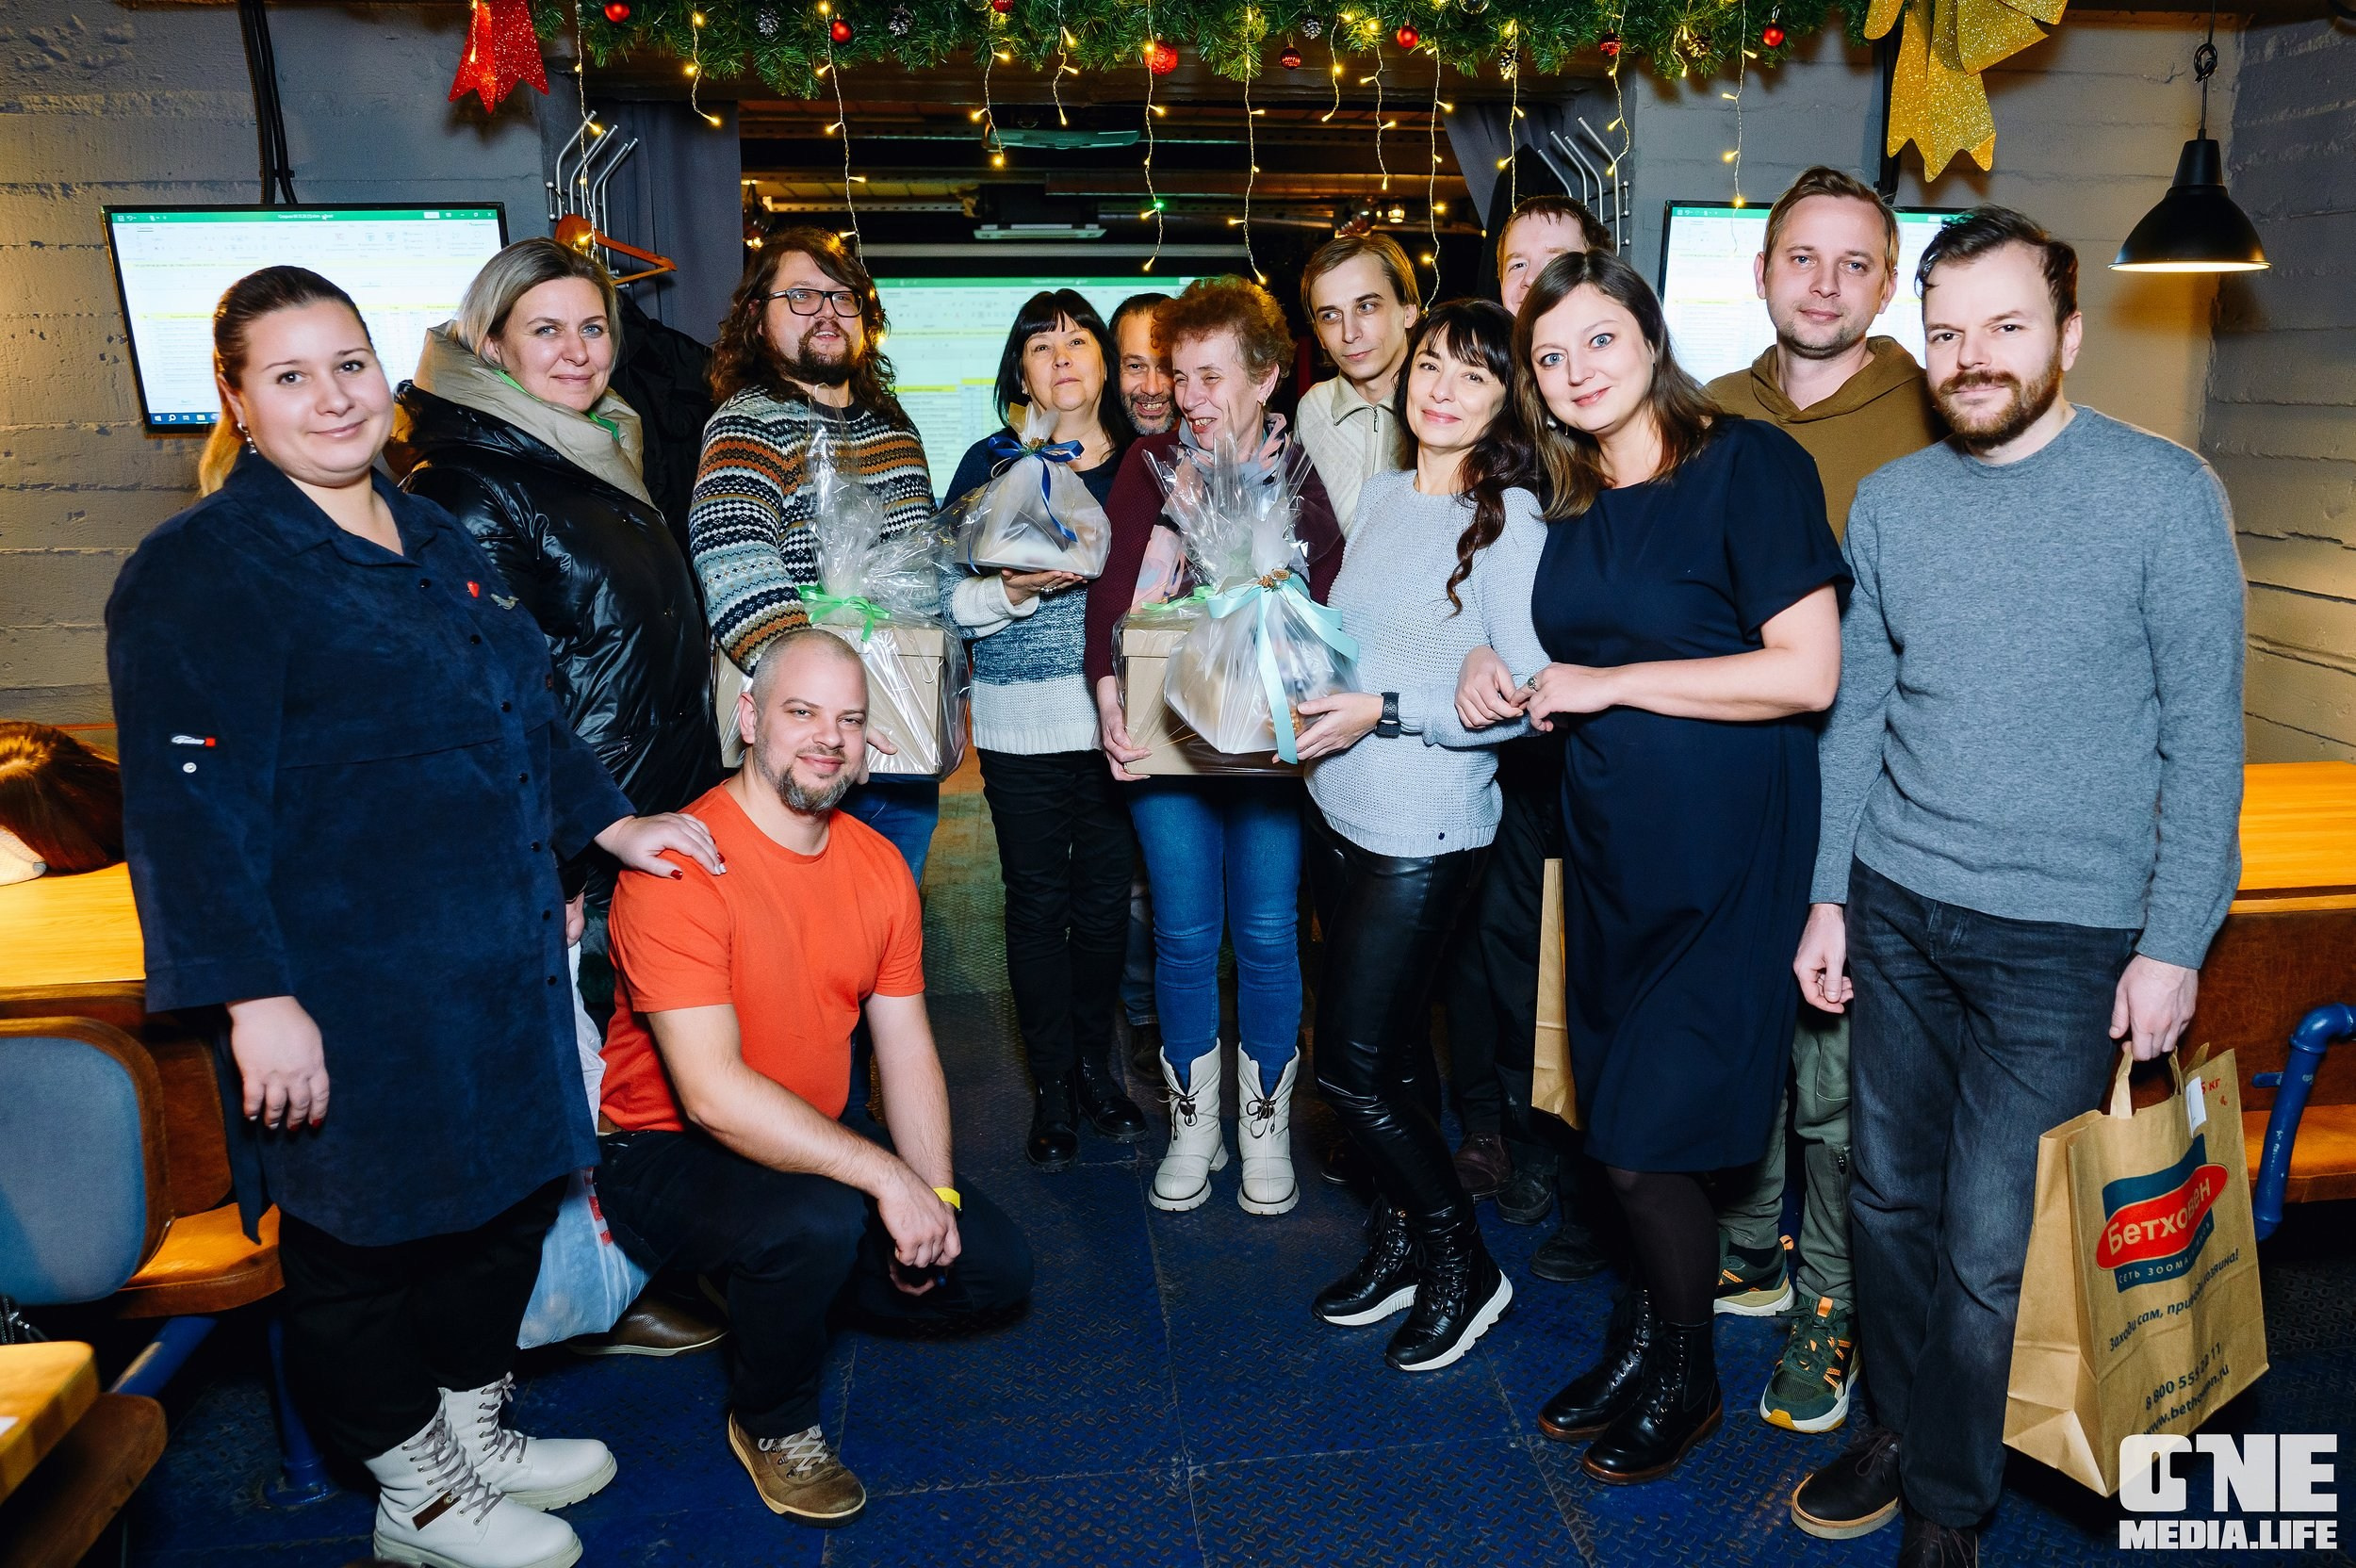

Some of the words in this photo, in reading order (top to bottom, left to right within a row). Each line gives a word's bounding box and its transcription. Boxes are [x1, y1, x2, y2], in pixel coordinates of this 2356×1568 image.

[2106, 1177, 2212, 1256] Бетховен
[2118, 1270, 2141, 1284] СЕТЬ
[2109, 1318, 2137, 1352] Заходи
[2137, 1308, 2164, 1326] сам,
[2145, 1396, 2152, 1411] 8
[2152, 1380, 2175, 1404] 800
[2210, 1342, 2221, 1360] 11
